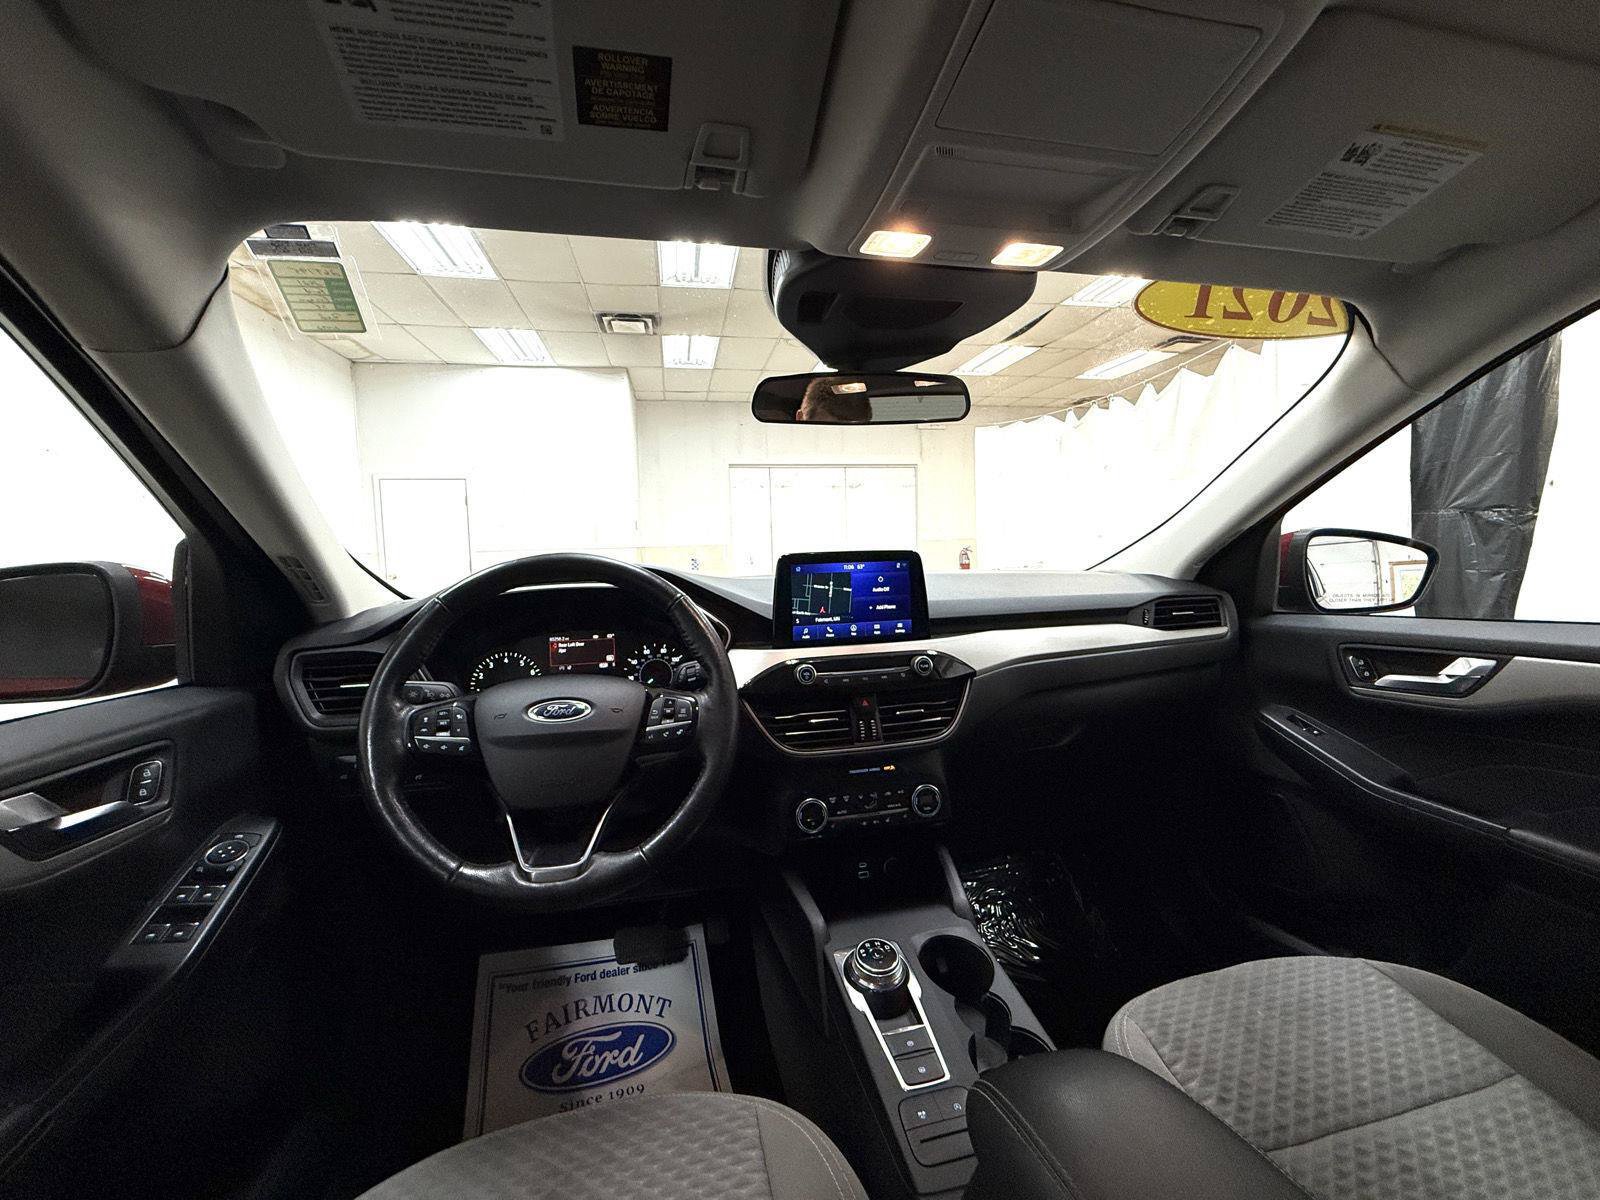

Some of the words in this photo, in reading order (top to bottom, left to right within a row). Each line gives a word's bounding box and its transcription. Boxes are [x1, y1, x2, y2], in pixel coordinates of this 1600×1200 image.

[598, 53, 648, 65] ROLLOVER
[601, 63, 645, 74] WARNING
[592, 87, 605, 95] DE
[593, 104, 654, 116] ADVERTENCIA
[622, 113, 657, 124] VUELCO
[488, 661, 494, 669] 3
[519, 659, 525, 667] 5
[543, 704, 577, 716] Ford
[533, 975, 572, 989] friendly
[574, 970, 597, 983] Ford
[599, 966, 630, 979] dealer
[524, 992, 673, 1043] FAIRMONT
[551, 1030, 645, 1084] Ford
[609, 1083, 645, 1100] 1909
